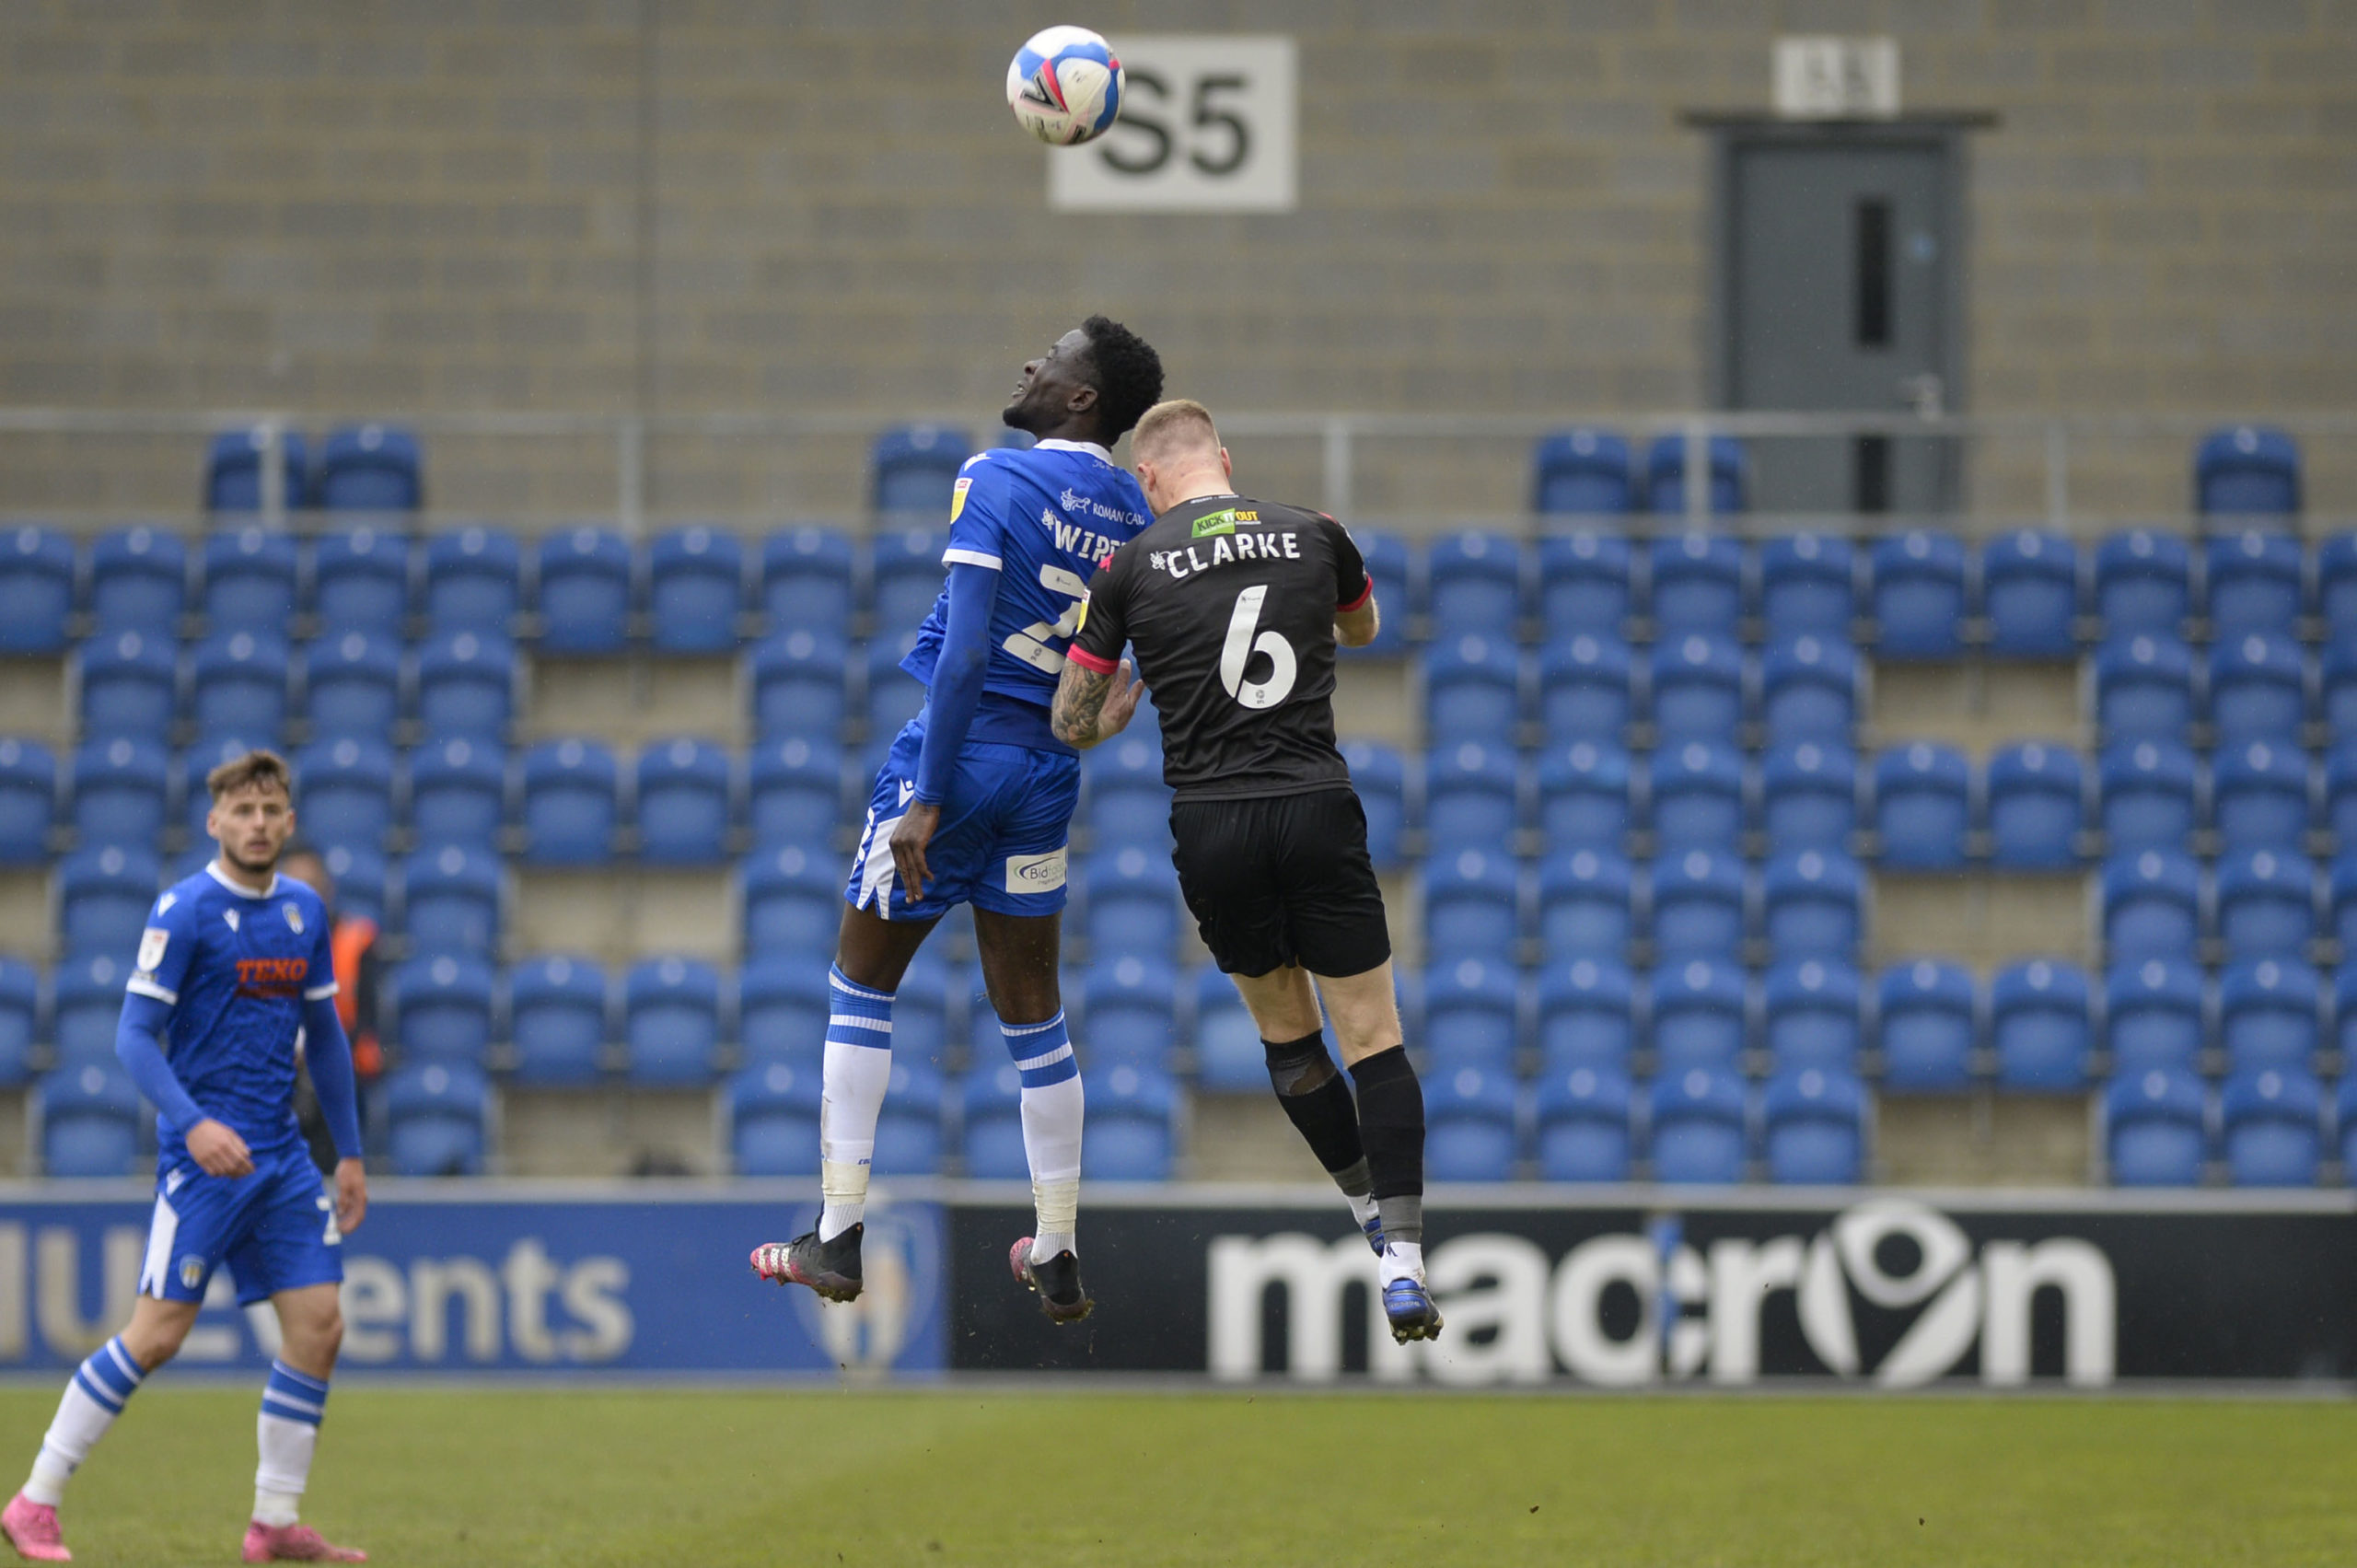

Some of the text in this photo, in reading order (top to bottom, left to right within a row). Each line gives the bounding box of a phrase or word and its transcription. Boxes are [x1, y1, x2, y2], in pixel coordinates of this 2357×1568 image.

[1097, 66, 1250, 176] S5
[1093, 503, 1124, 523] ROMAN
[1197, 516, 1224, 531] KICK
[1223, 512, 1234, 522] IT
[1236, 511, 1258, 521] OUT
[1167, 532, 1300, 578] CLARKE
[1220, 585, 1296, 709] 6
[1207, 1199, 2117, 1386] macron
